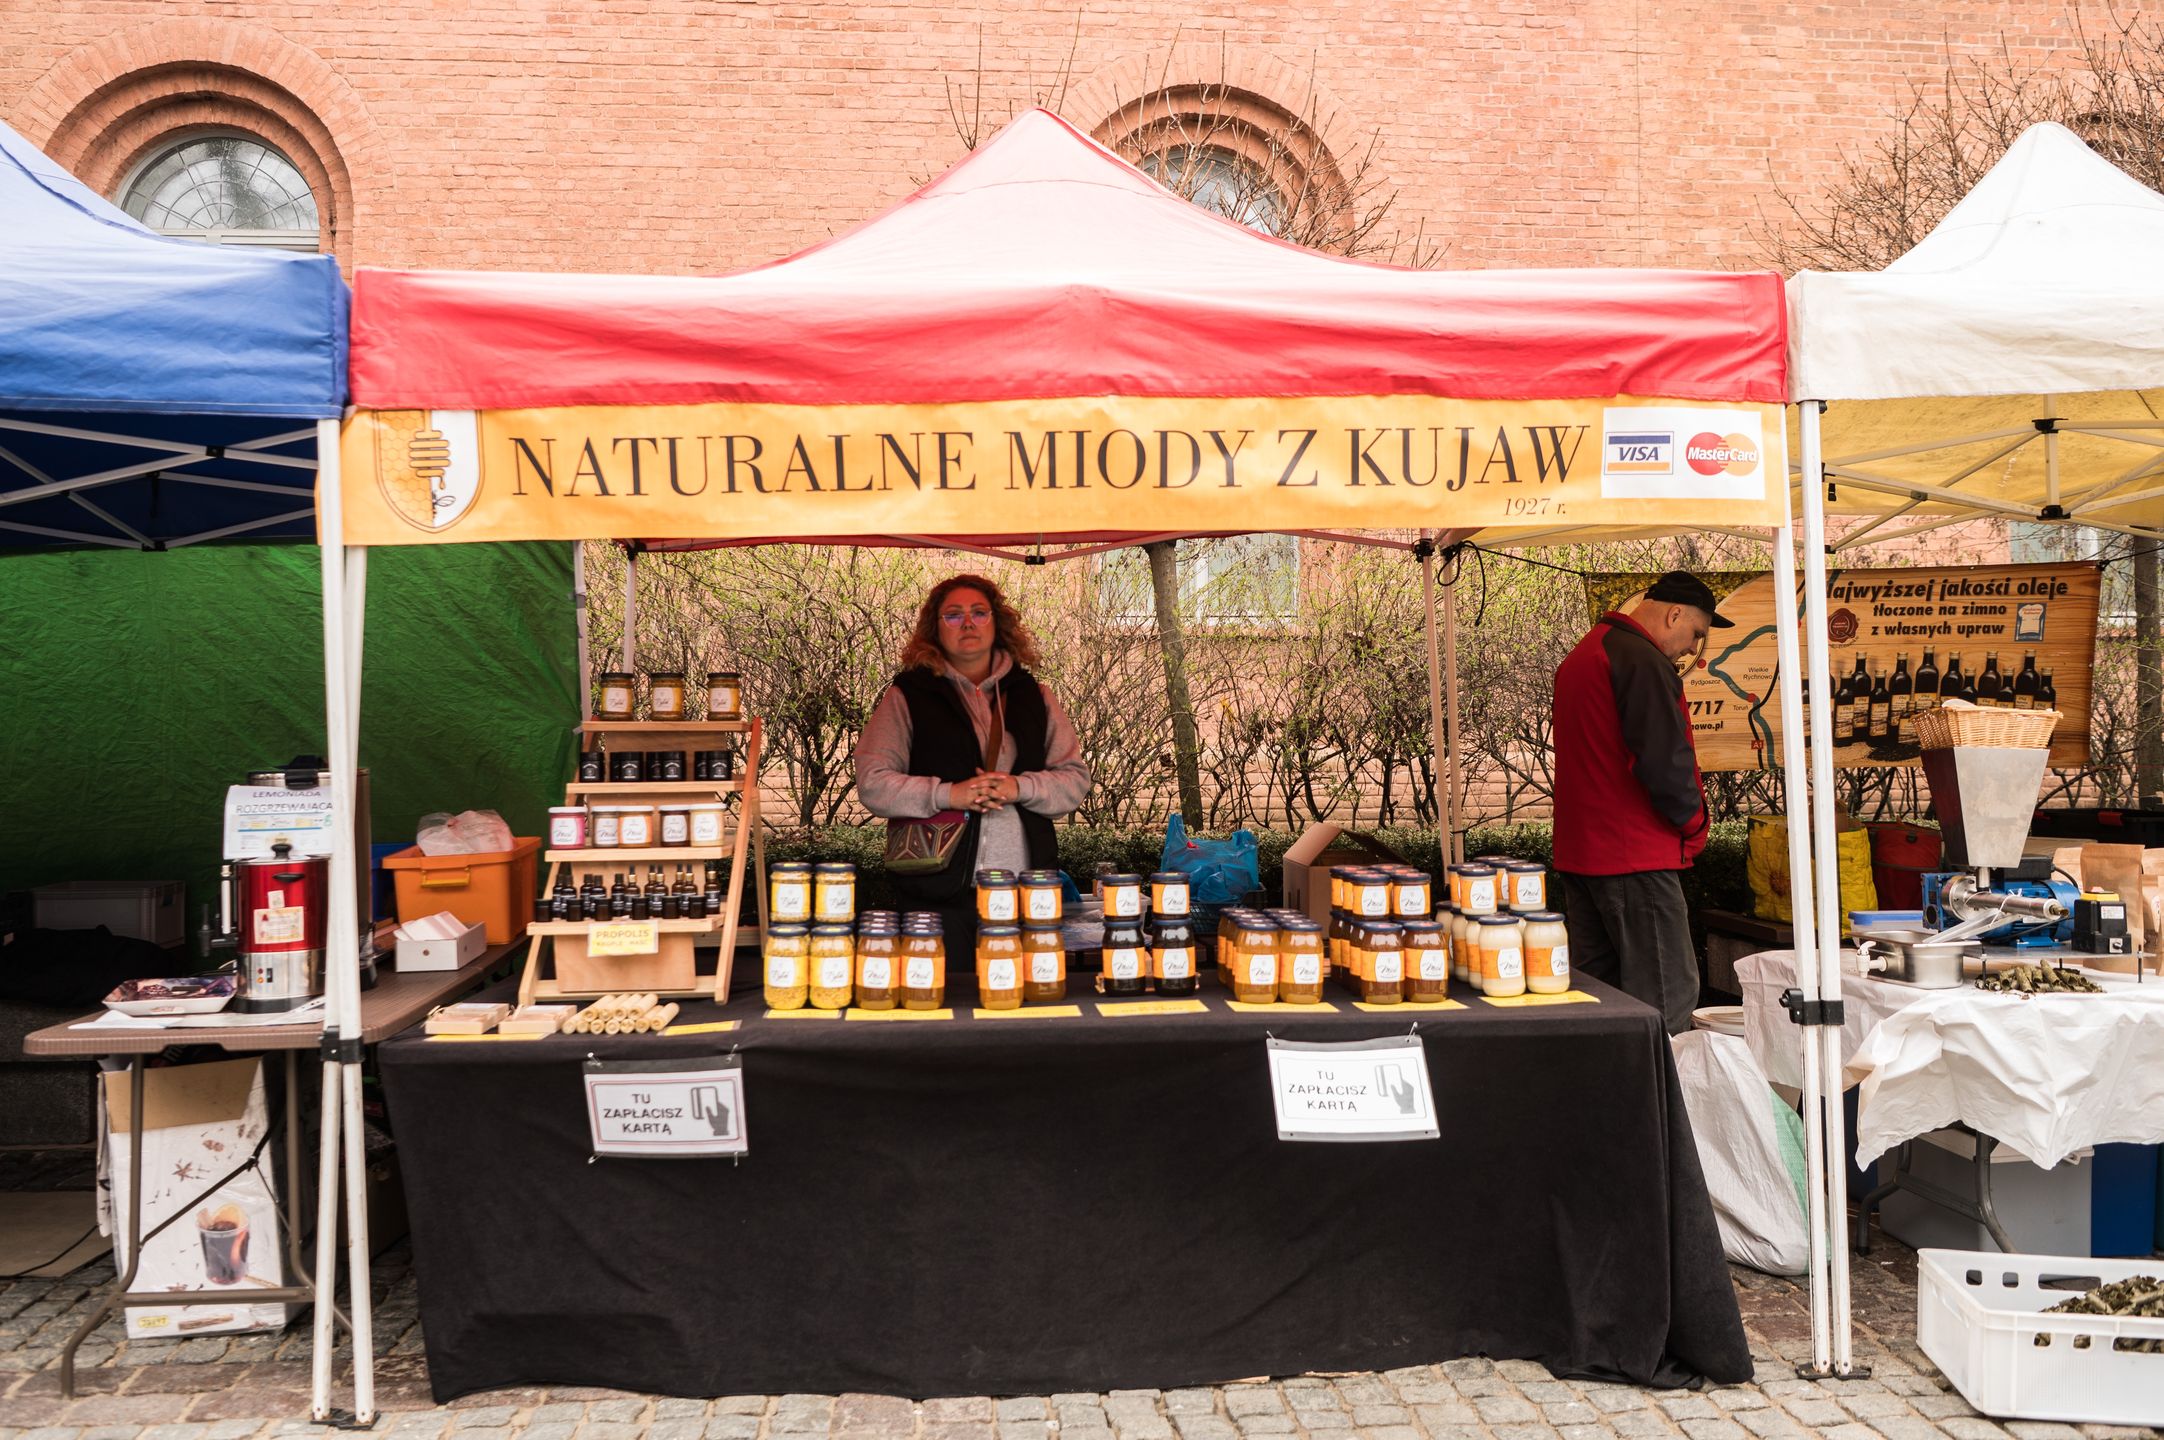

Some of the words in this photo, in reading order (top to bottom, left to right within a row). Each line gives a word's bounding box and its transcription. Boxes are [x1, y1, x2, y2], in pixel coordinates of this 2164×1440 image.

[1618, 446, 1660, 462] VISA
[1687, 446, 1758, 463] MasterCard
[508, 431, 977, 498] NATURALNE
[1003, 428, 1256, 491] MIODY
[1276, 428, 1319, 488] Z
[1344, 424, 1591, 493] KUJAW
[1503, 497, 1552, 517] 1927
[1939, 577, 2012, 602] jakości
[2016, 576, 2068, 601] oleje
[1873, 602, 1933, 617] tłoczone
[1938, 603, 1957, 616] na
[1962, 601, 2007, 616] zimno
[1871, 624, 1880, 636] z
[1884, 622, 1951, 639] własnych
[1957, 623, 2006, 639] upraw
[1690, 679, 1721, 687] Bydgoszcz
[1743, 673, 1773, 681] Rychnowo
[253, 791, 321, 799] LEMONIADA
[596, 928, 650, 939] PROPOLIS
[1317, 1070, 1335, 1081] TU
[1288, 1083, 1368, 1096] ZAPŁACISZ
[632, 1093, 651, 1104] TU
[604, 1107, 684, 1119] ZAPŁACISZ
[1306, 1100, 1358, 1113] KARTĄ
[622, 1122, 673, 1136] KARTĄ
